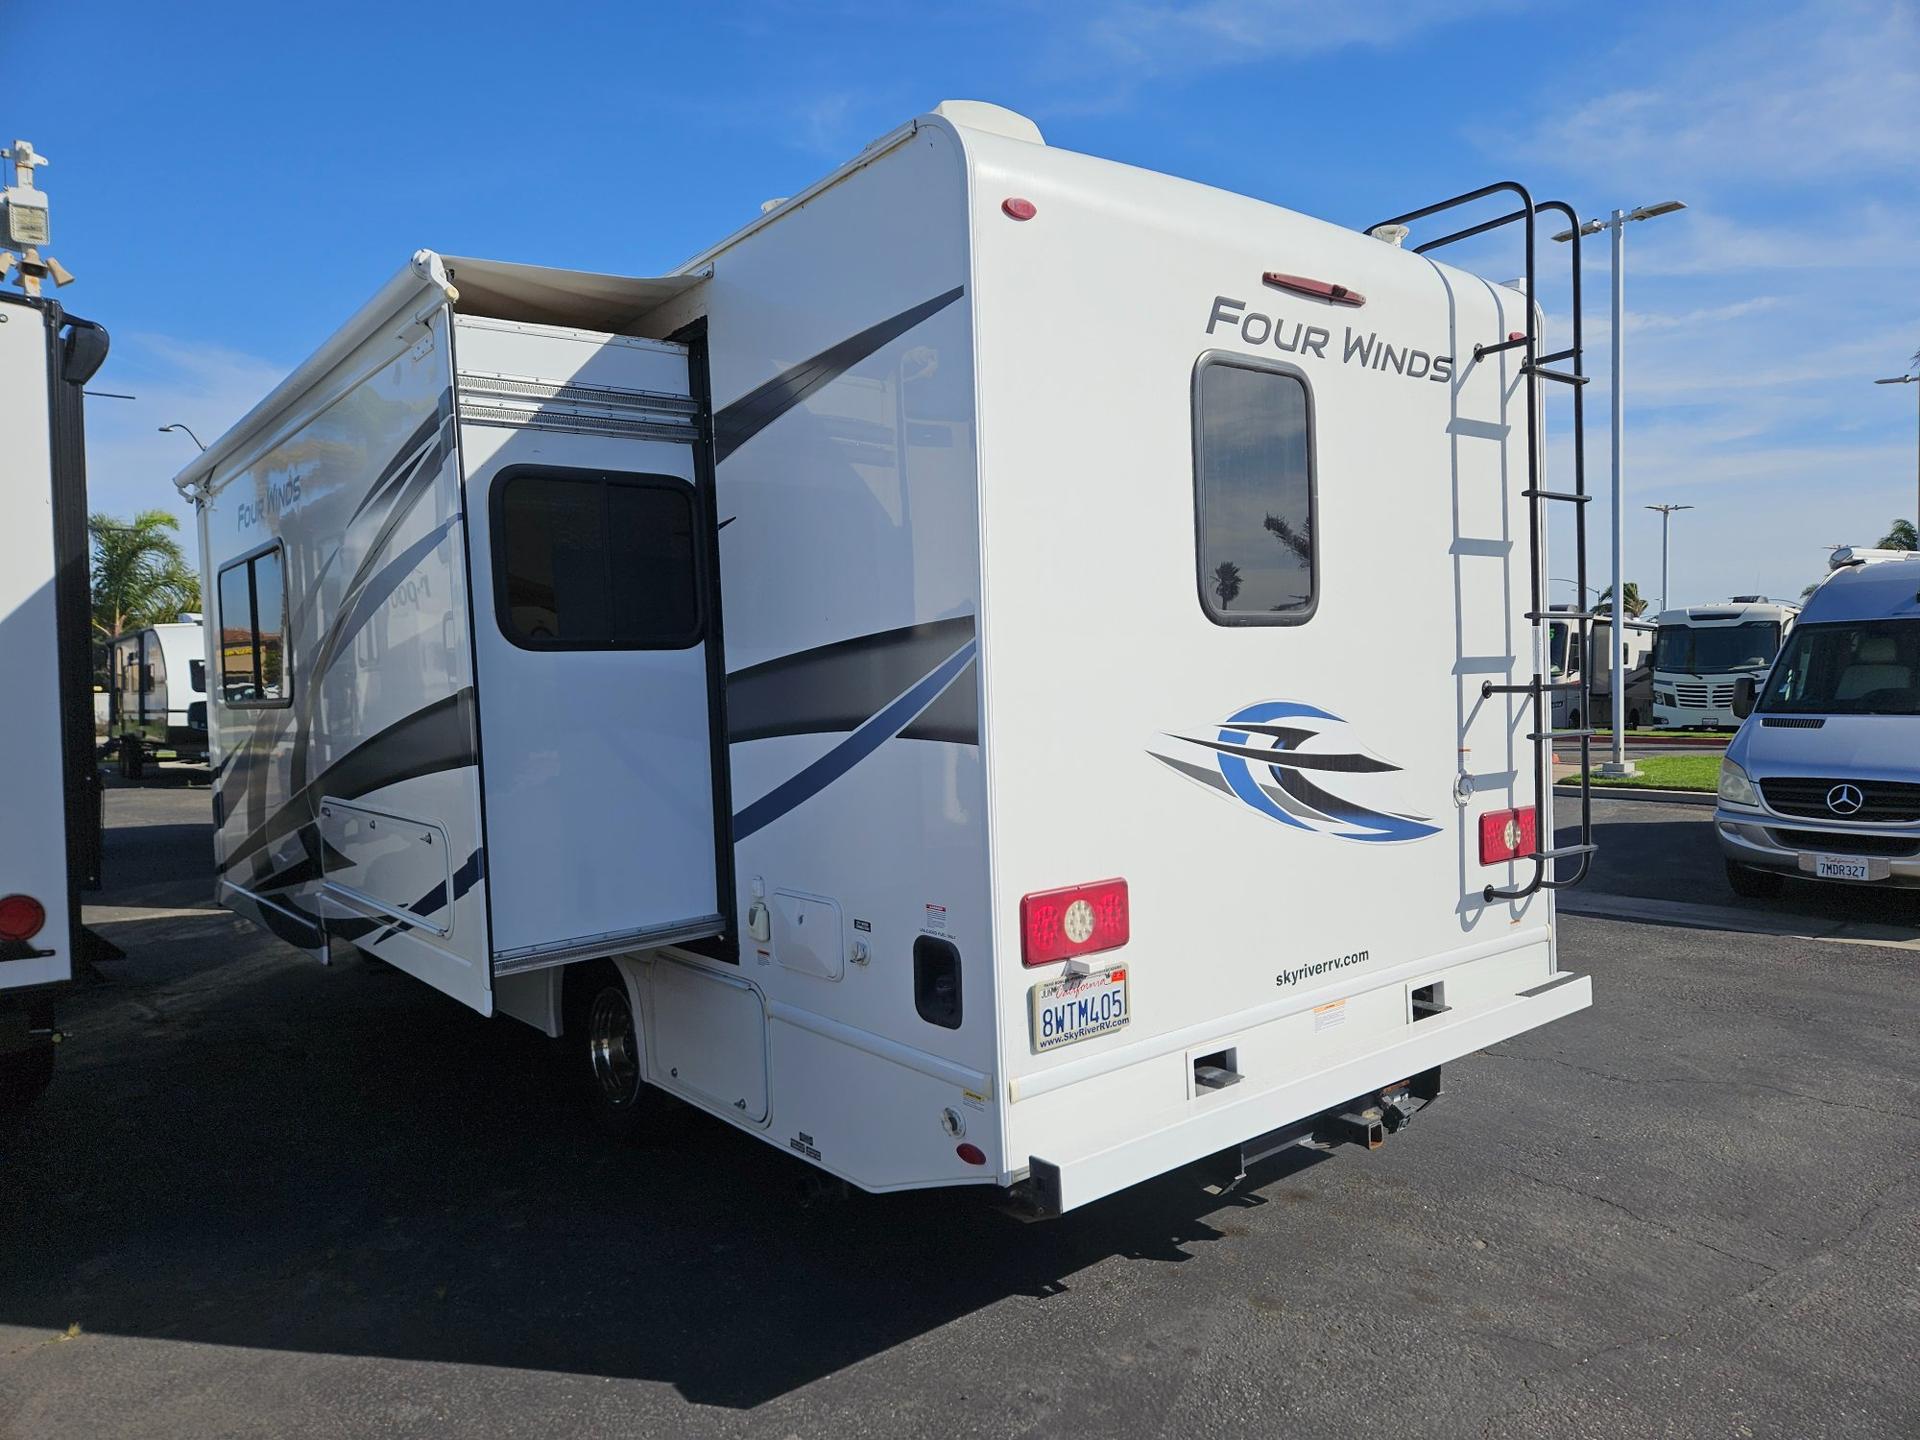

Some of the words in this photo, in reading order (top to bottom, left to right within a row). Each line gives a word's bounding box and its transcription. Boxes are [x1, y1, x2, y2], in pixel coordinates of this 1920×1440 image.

[1206, 296, 1330, 359] FOUR
[1343, 326, 1453, 383] WINDS
[1820, 863, 1865, 877] 7MDR327
[1276, 950, 1369, 986] skyriverrv.com
[1043, 989, 1122, 1038] 8WTM405
[1040, 1017, 1130, 1048] www.SkyRiverRV.com
